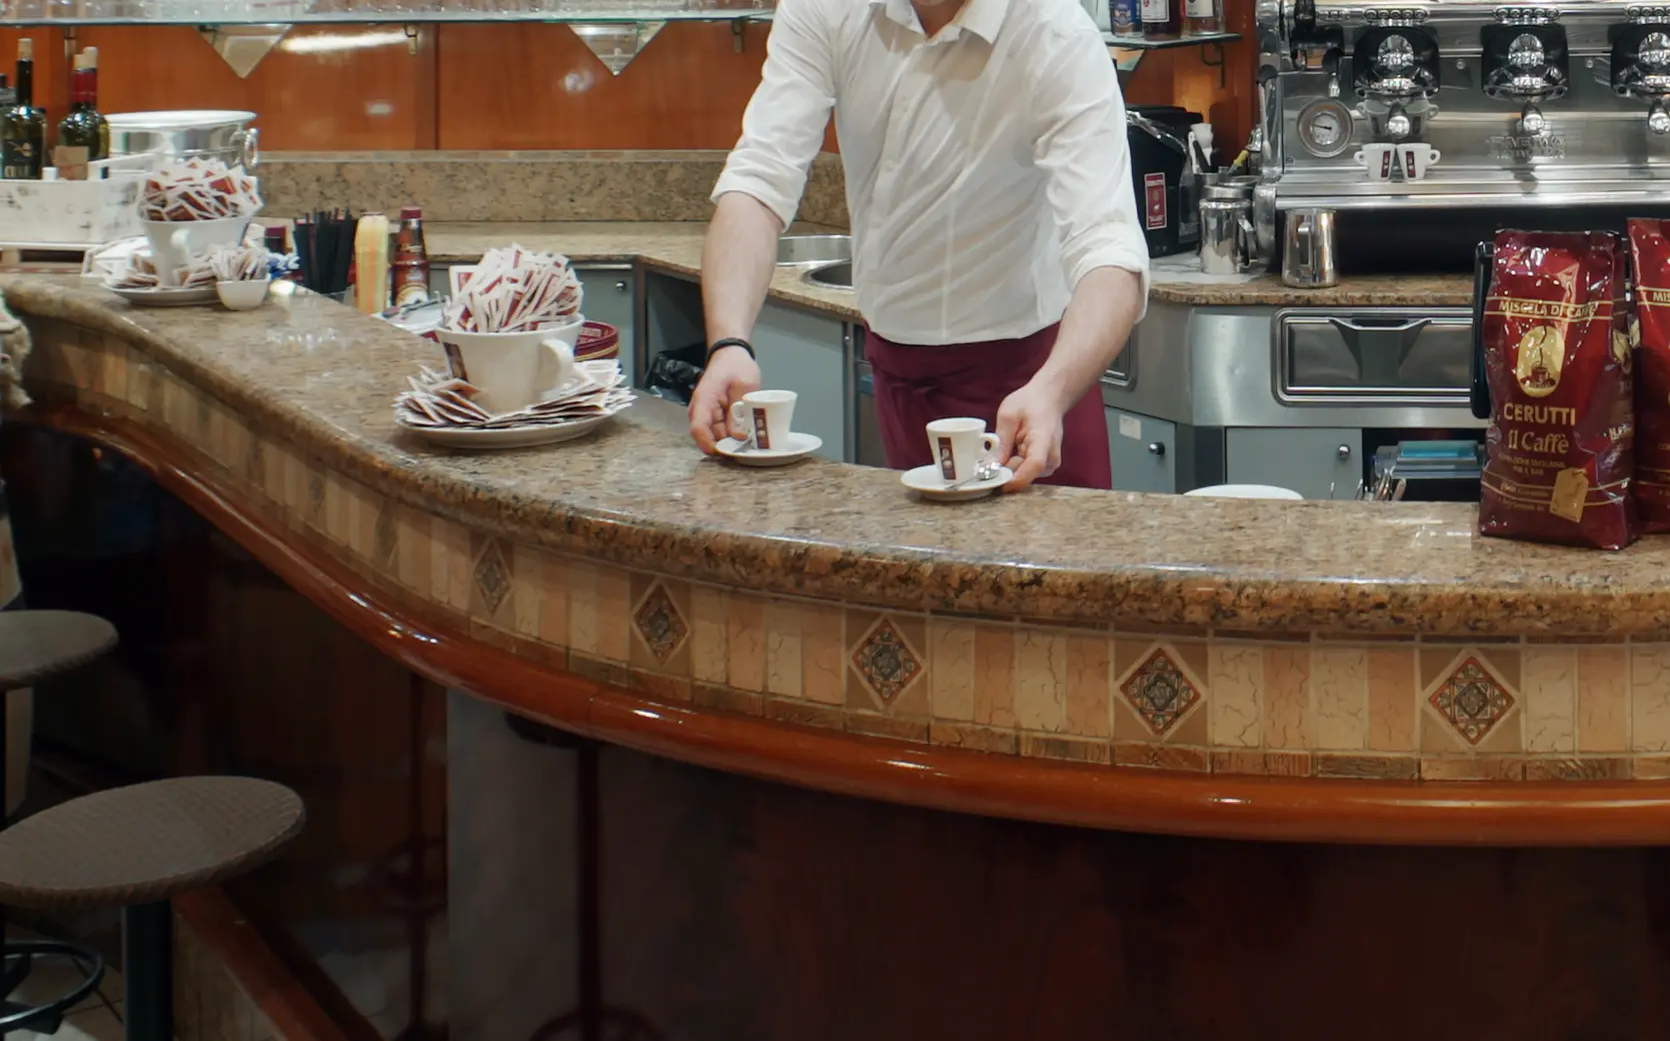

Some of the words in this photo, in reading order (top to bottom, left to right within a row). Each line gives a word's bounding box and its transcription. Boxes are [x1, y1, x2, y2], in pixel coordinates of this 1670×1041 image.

[1503, 402, 1576, 427] CERUTTI
[1508, 429, 1519, 450] il
[1521, 430, 1570, 455] Caffè
